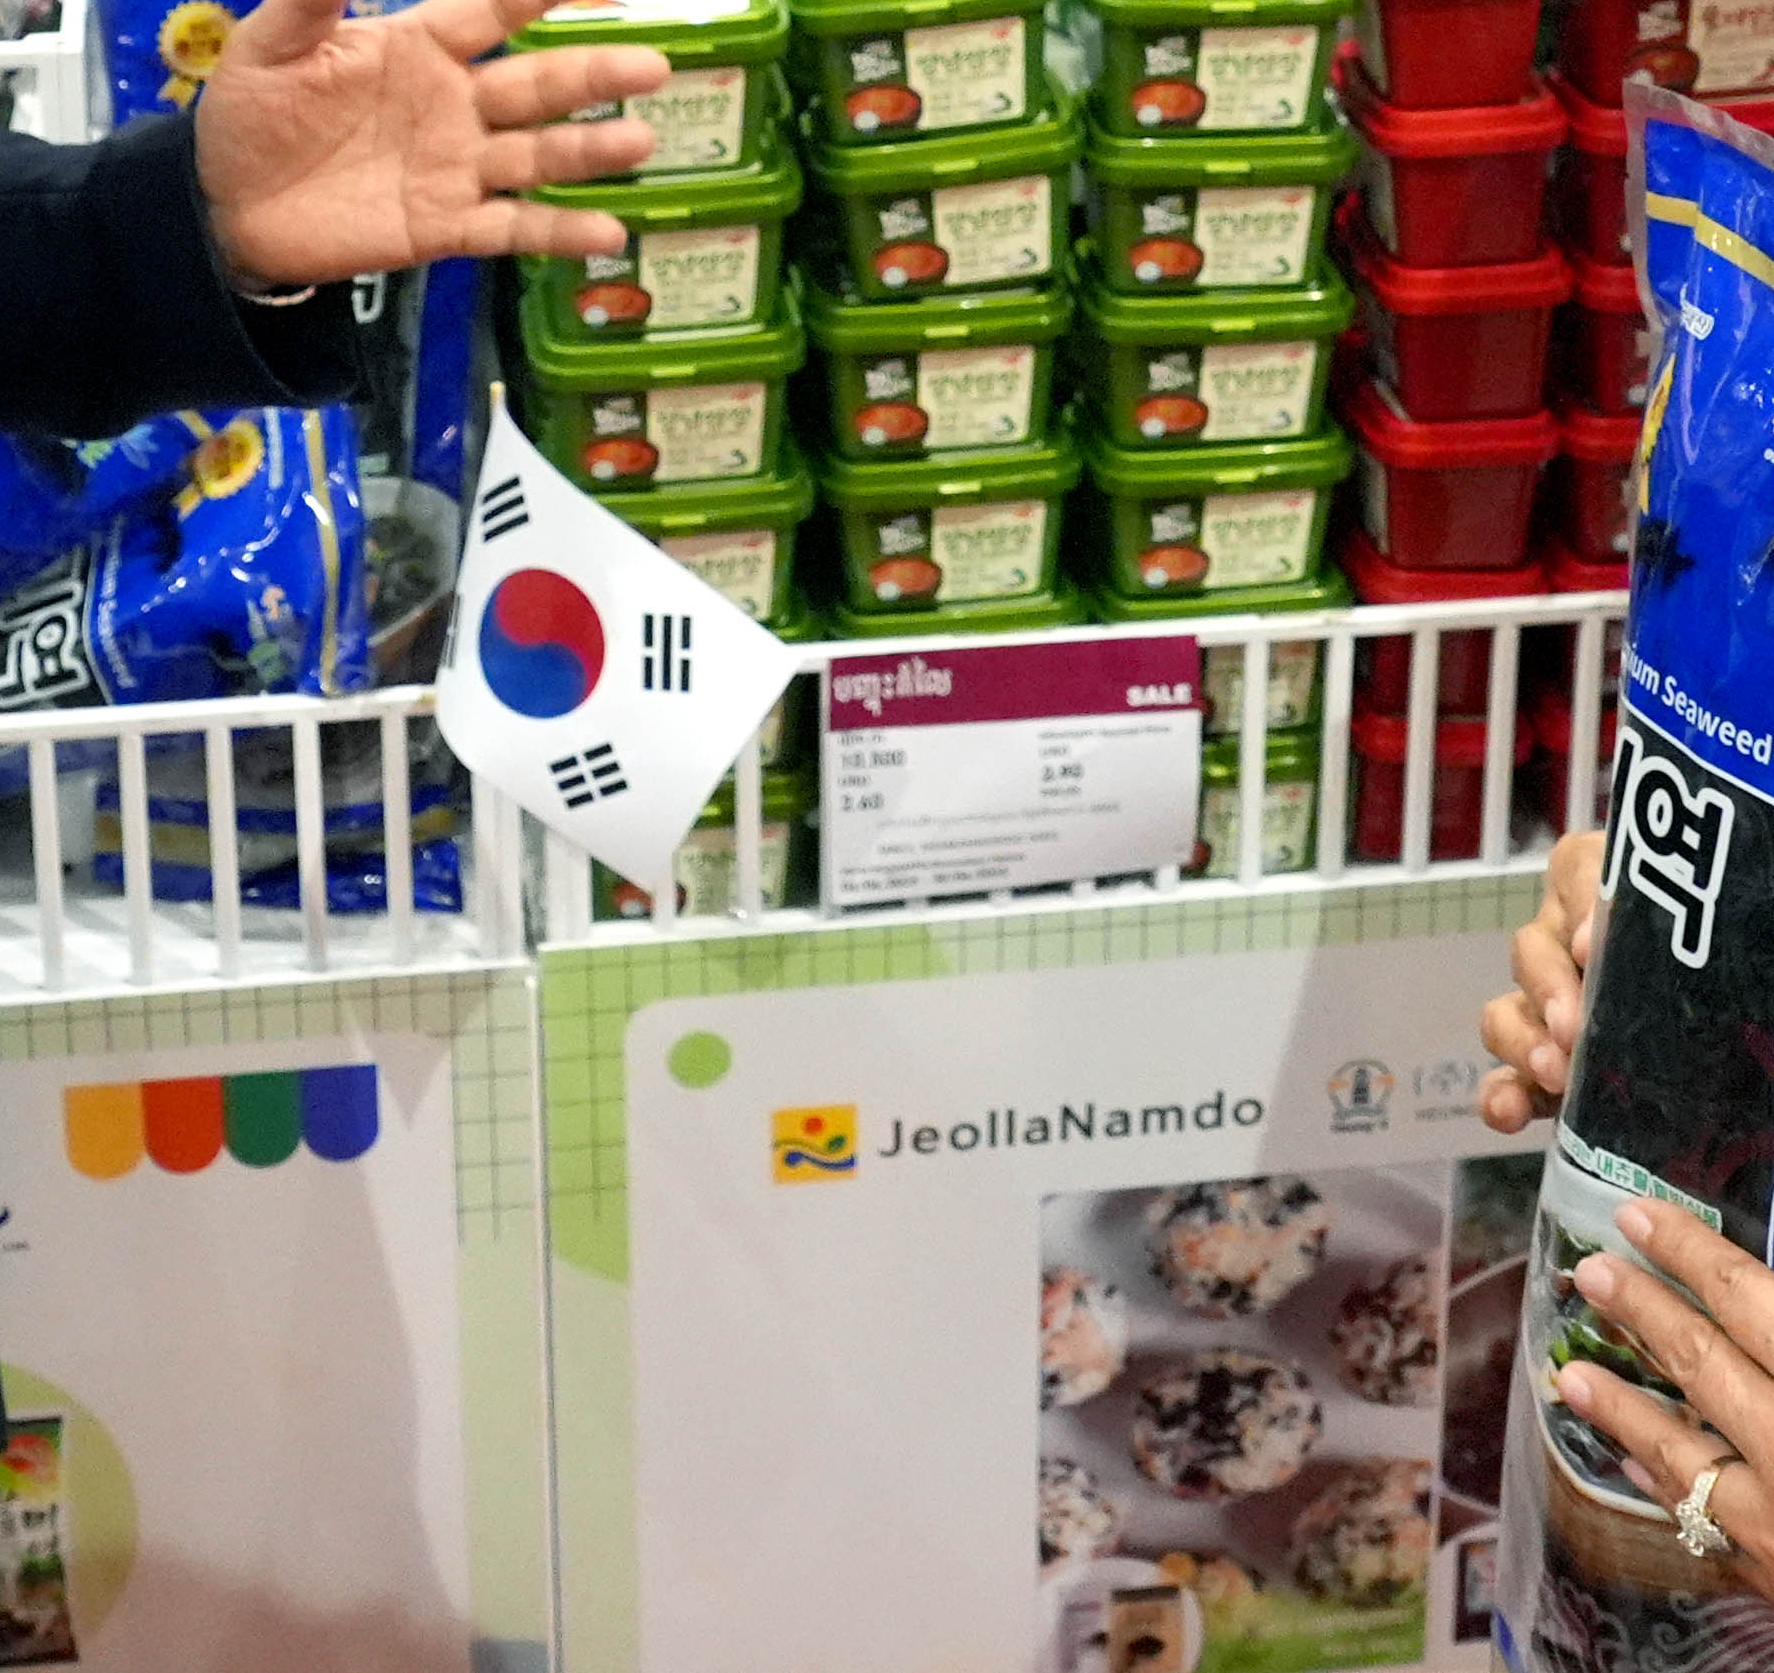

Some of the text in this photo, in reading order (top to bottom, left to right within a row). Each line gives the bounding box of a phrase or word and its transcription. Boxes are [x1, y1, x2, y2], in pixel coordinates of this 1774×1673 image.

[1126, 683, 1193, 708] SALE
[1661, 676, 1774, 766] Seaweed
[877, 1090, 1266, 1159] JeollaNamdo
